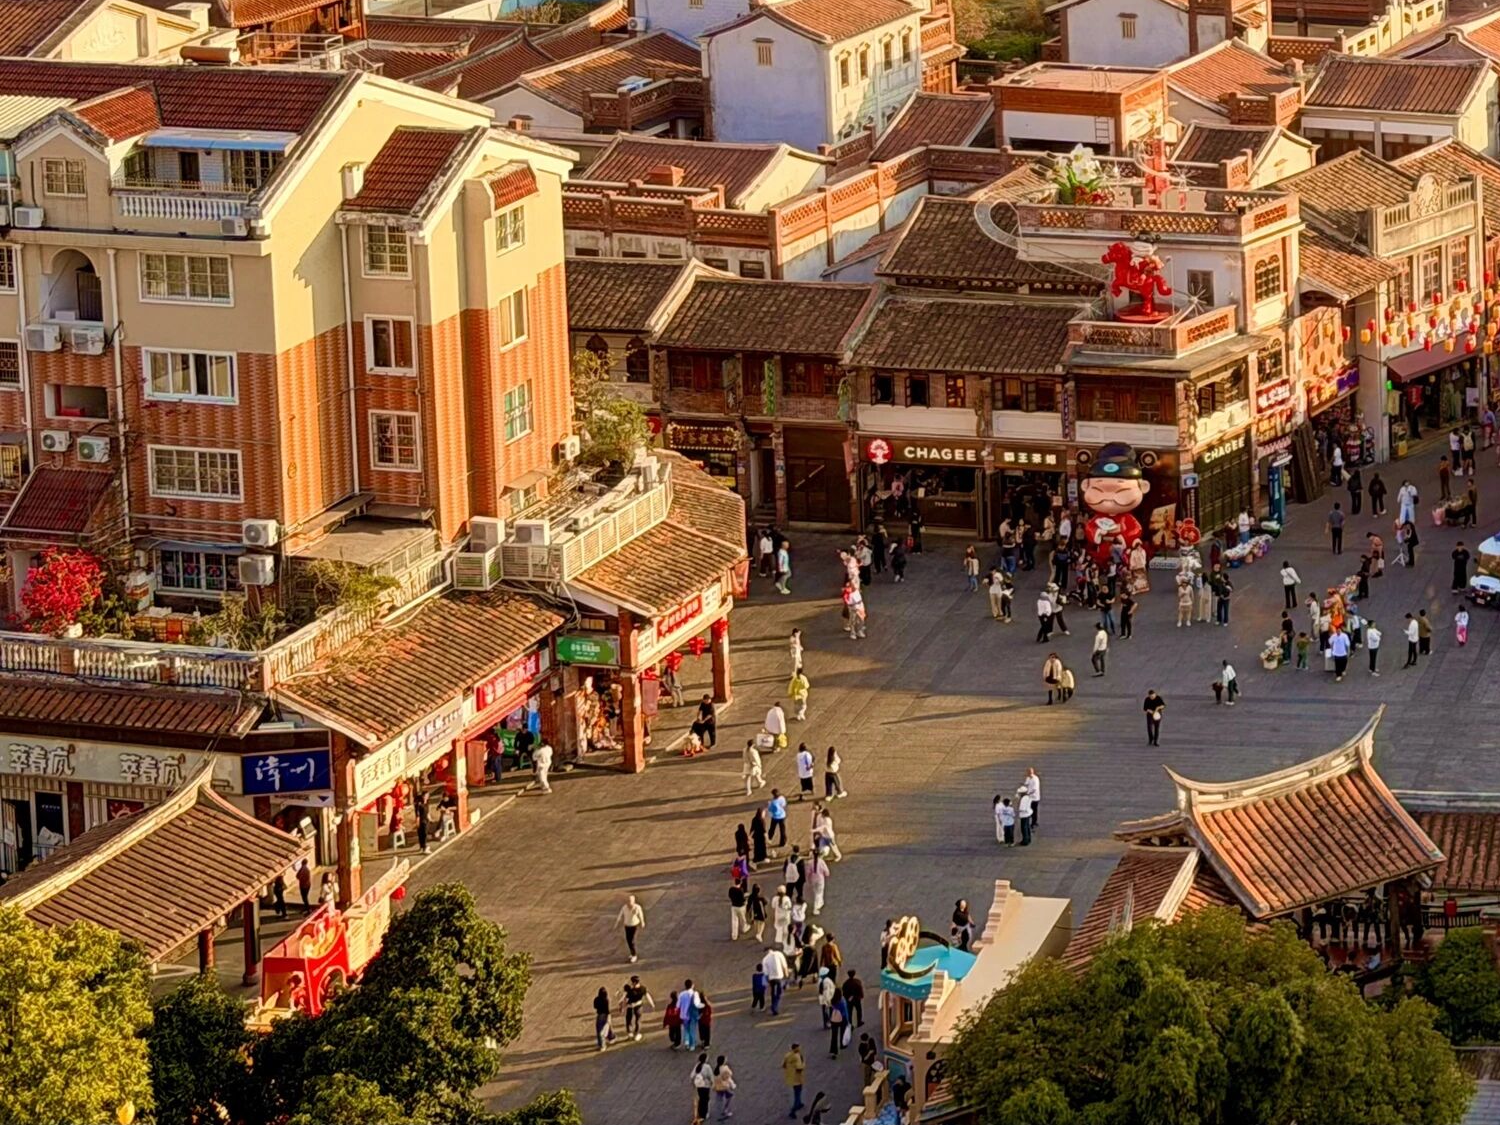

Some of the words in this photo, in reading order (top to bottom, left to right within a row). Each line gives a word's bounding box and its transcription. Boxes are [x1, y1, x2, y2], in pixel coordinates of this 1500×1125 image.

[903, 445, 977, 462] CHAGEE
[1003, 451, 1057, 465] 霸王茶姬
[1203, 437, 1246, 464] CHAGEE
